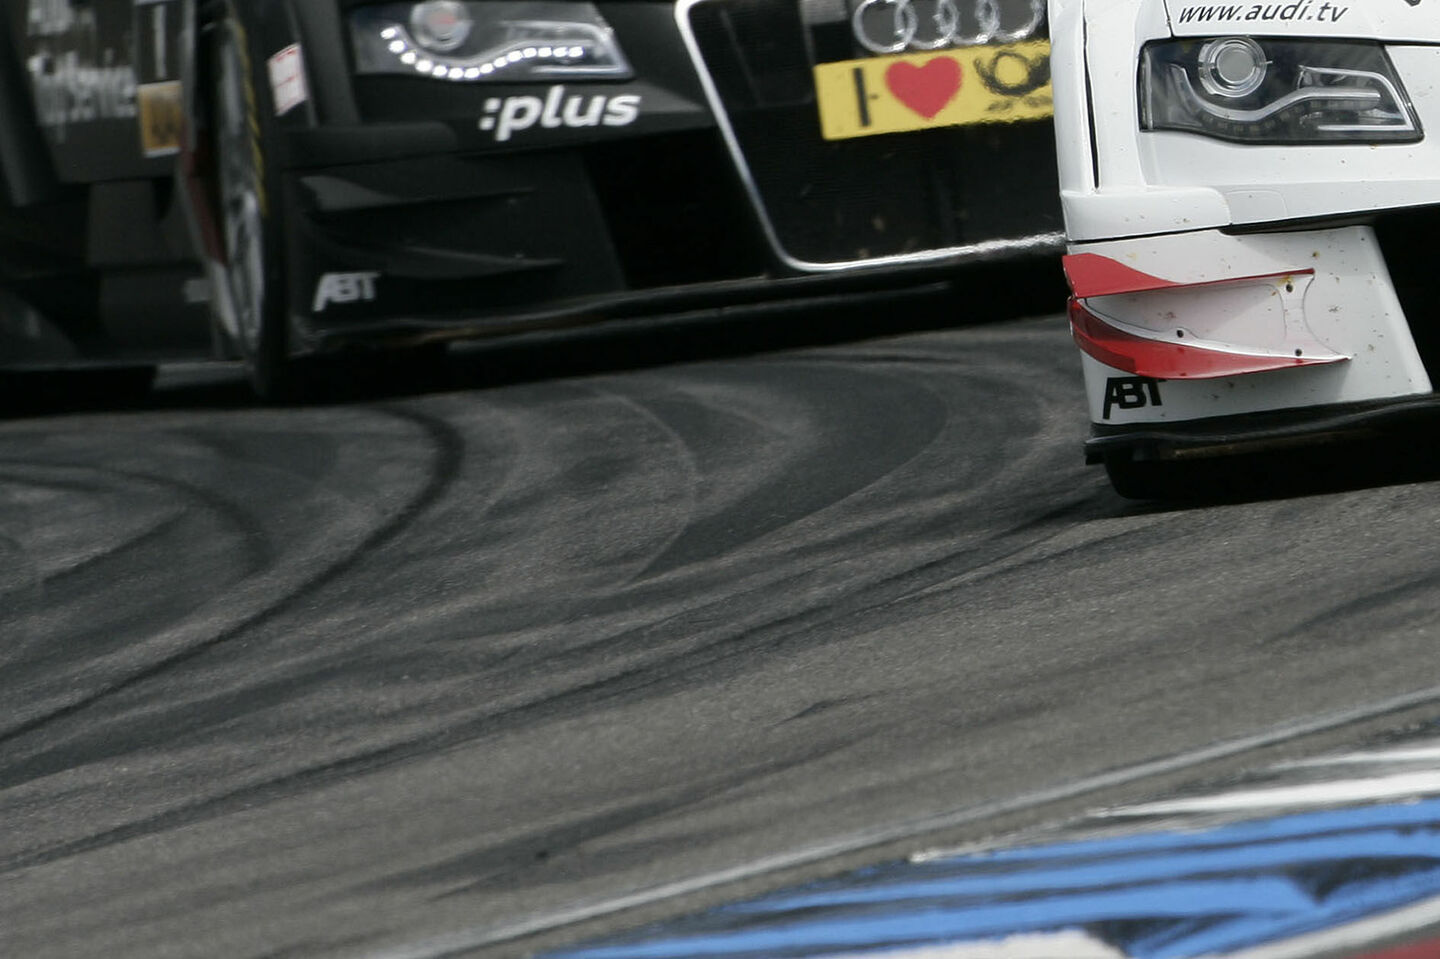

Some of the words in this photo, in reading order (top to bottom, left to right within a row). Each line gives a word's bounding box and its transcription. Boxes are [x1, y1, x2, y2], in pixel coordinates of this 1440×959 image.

[478, 84, 643, 142] :plus
[312, 270, 382, 312] ABT
[1101, 375, 1168, 421] ABT
